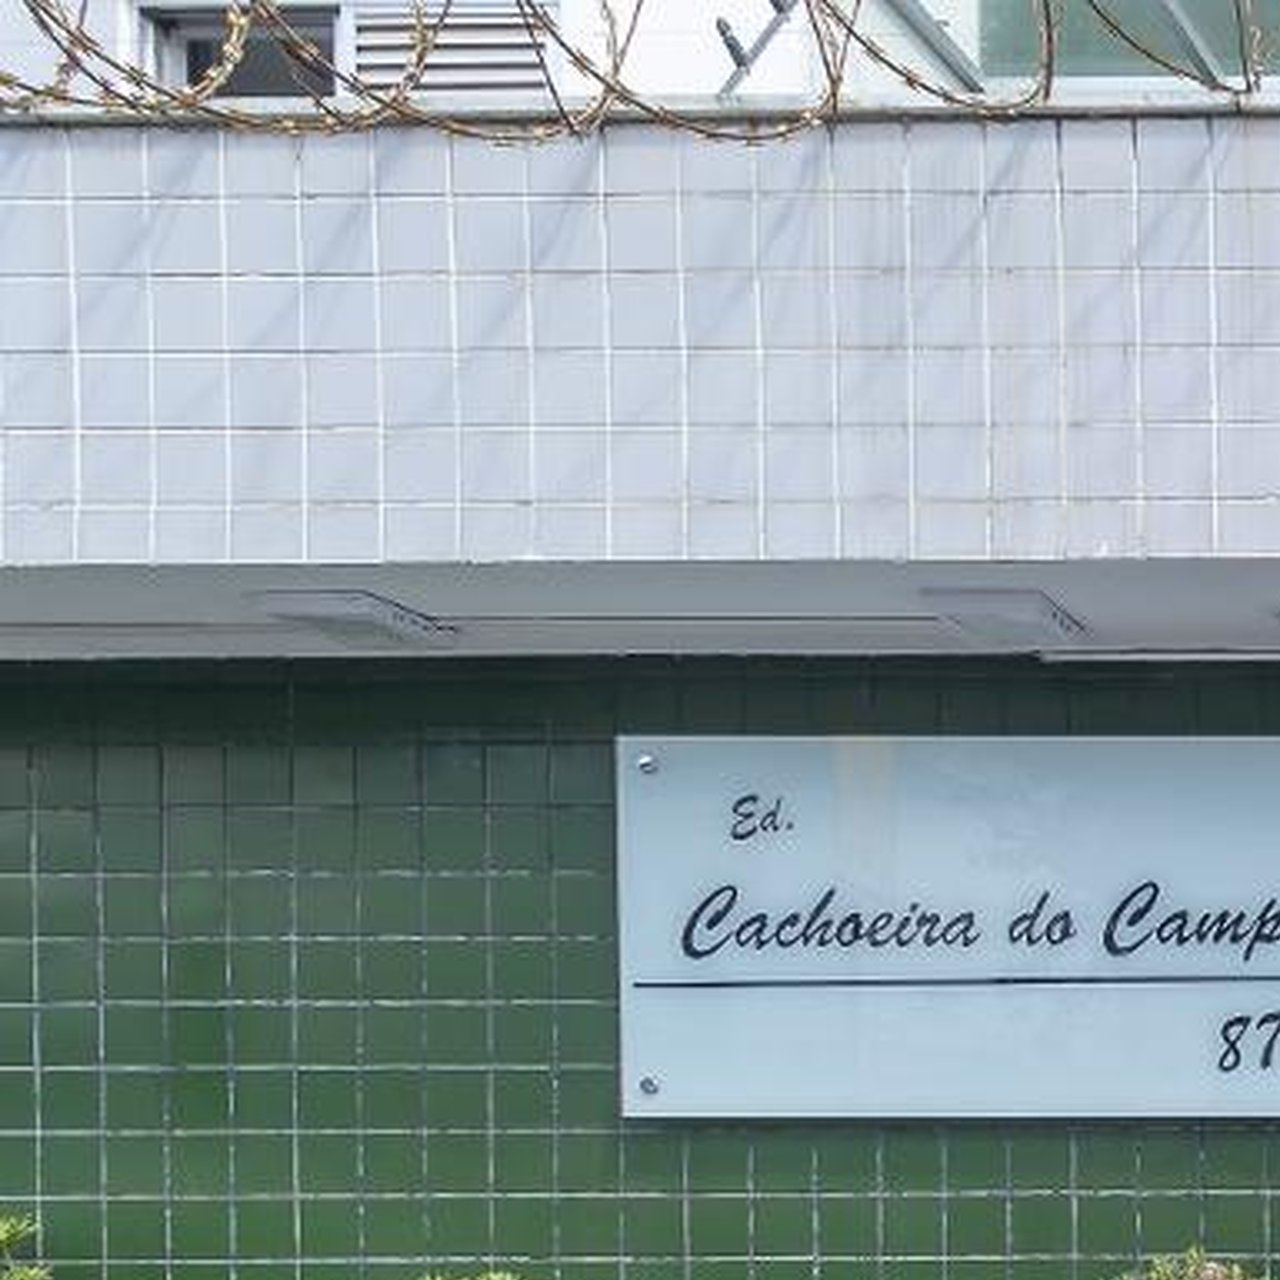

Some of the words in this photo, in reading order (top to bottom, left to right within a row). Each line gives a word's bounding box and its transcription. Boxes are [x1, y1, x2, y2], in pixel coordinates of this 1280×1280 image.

[729, 793, 795, 841] Ed.
[680, 884, 982, 961] Cachoeira
[1007, 889, 1078, 949] do
